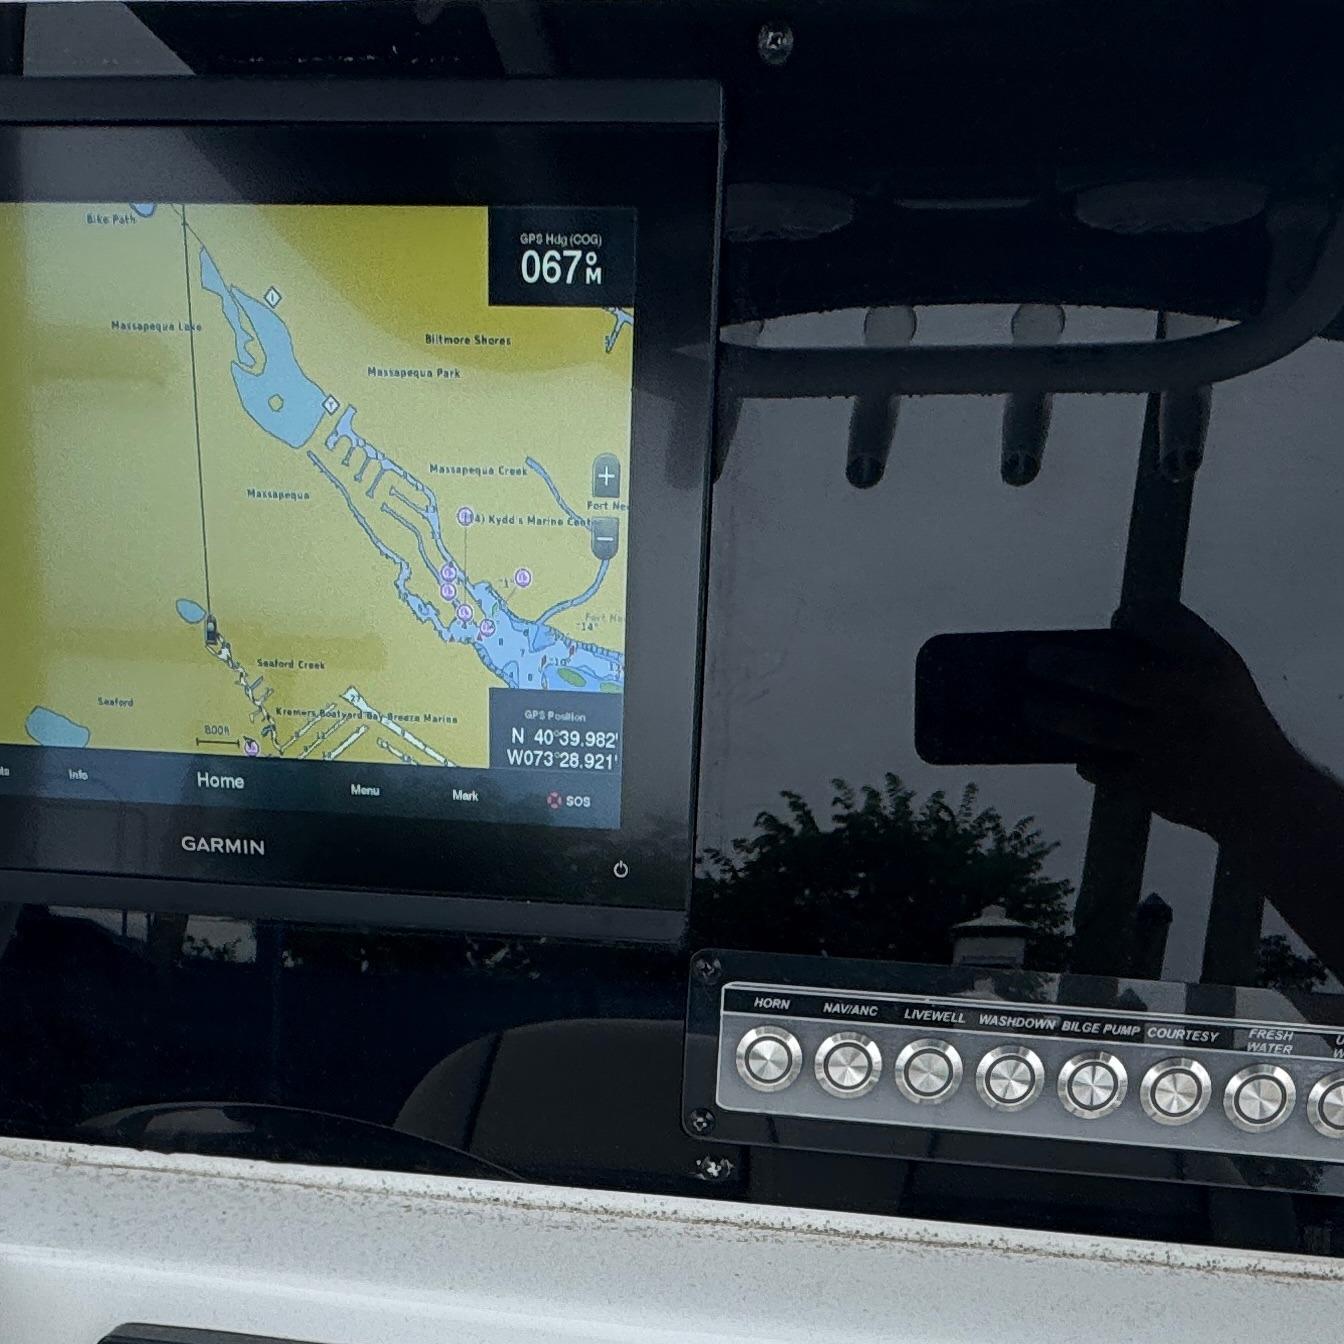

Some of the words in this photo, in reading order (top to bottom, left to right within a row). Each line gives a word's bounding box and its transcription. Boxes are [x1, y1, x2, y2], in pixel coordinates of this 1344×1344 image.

[110, 215, 137, 225] Path
[520, 233, 543, 245] GPS
[545, 233, 568, 248] Hdg
[570, 234, 602, 247] (COG)
[425, 334, 472, 345] Biltmore
[474, 335, 512, 346] Shores
[367, 367, 434, 381] Massapequa
[436, 368, 462, 379] Park
[429, 464, 495, 477] Massapequa
[497, 465, 529, 476] Creek
[246, 488, 310, 501] Massapequa
[587, 501, 609, 511] Fort
[527, 516, 564, 526] Marine
[567, 518, 592, 527] Cent
[257, 658, 294, 669] Seaford
[298, 660, 325, 670] Creek
[524, 710, 546, 721] GPS
[548, 710, 586, 722] Position
[511, 727, 525, 745] N
[67, 768, 89, 781] Info
[197, 771, 245, 789] Home
[350, 784, 381, 798] Menu
[452, 788, 479, 803] Mark
[566, 795, 591, 808] SOS
[181, 835, 265, 856] GARMIN
[753, 996, 791, 1011] HORN
[823, 1001, 879, 1017] NAV/ANC
[904, 1007, 967, 1024] LIVEWELL
[979, 1013, 1058, 1032] WASHDOWN
[1061, 1020, 1100, 1035] BILGE
[1102, 1023, 1142, 1037] PUMP
[1147, 1026, 1220, 1043] COURTESY
[1248, 1028, 1295, 1042] FRESH
[1246, 1041, 1293, 1056] WATER
